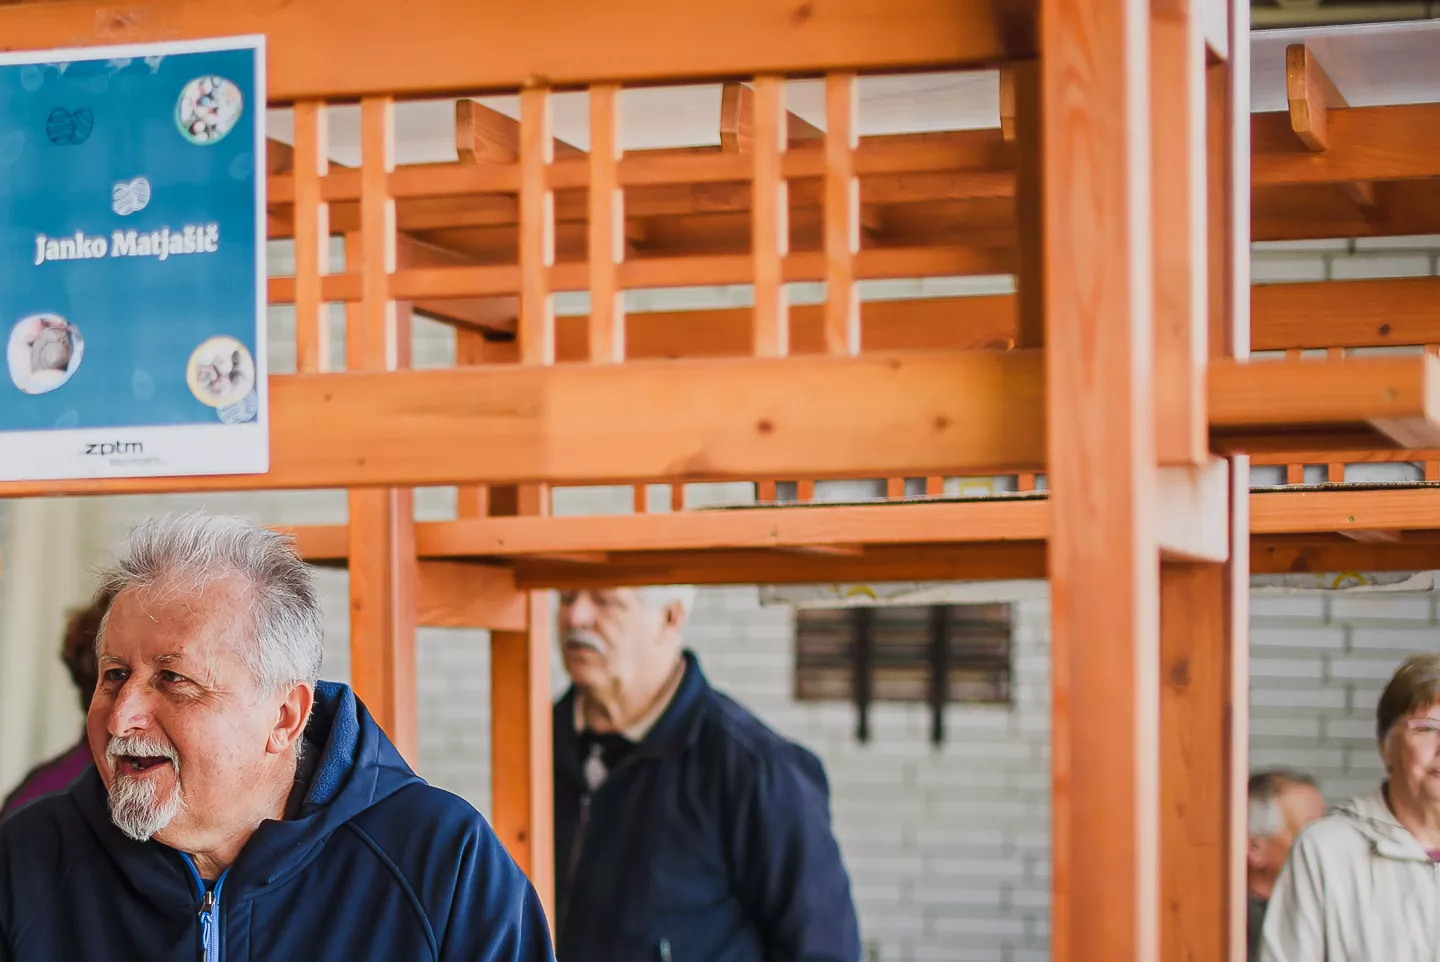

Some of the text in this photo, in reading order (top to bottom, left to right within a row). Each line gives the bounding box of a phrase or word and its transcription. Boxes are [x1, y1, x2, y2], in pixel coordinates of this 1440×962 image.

[35, 222, 219, 266] Janko Matjašič
[85, 441, 143, 456] zptm
